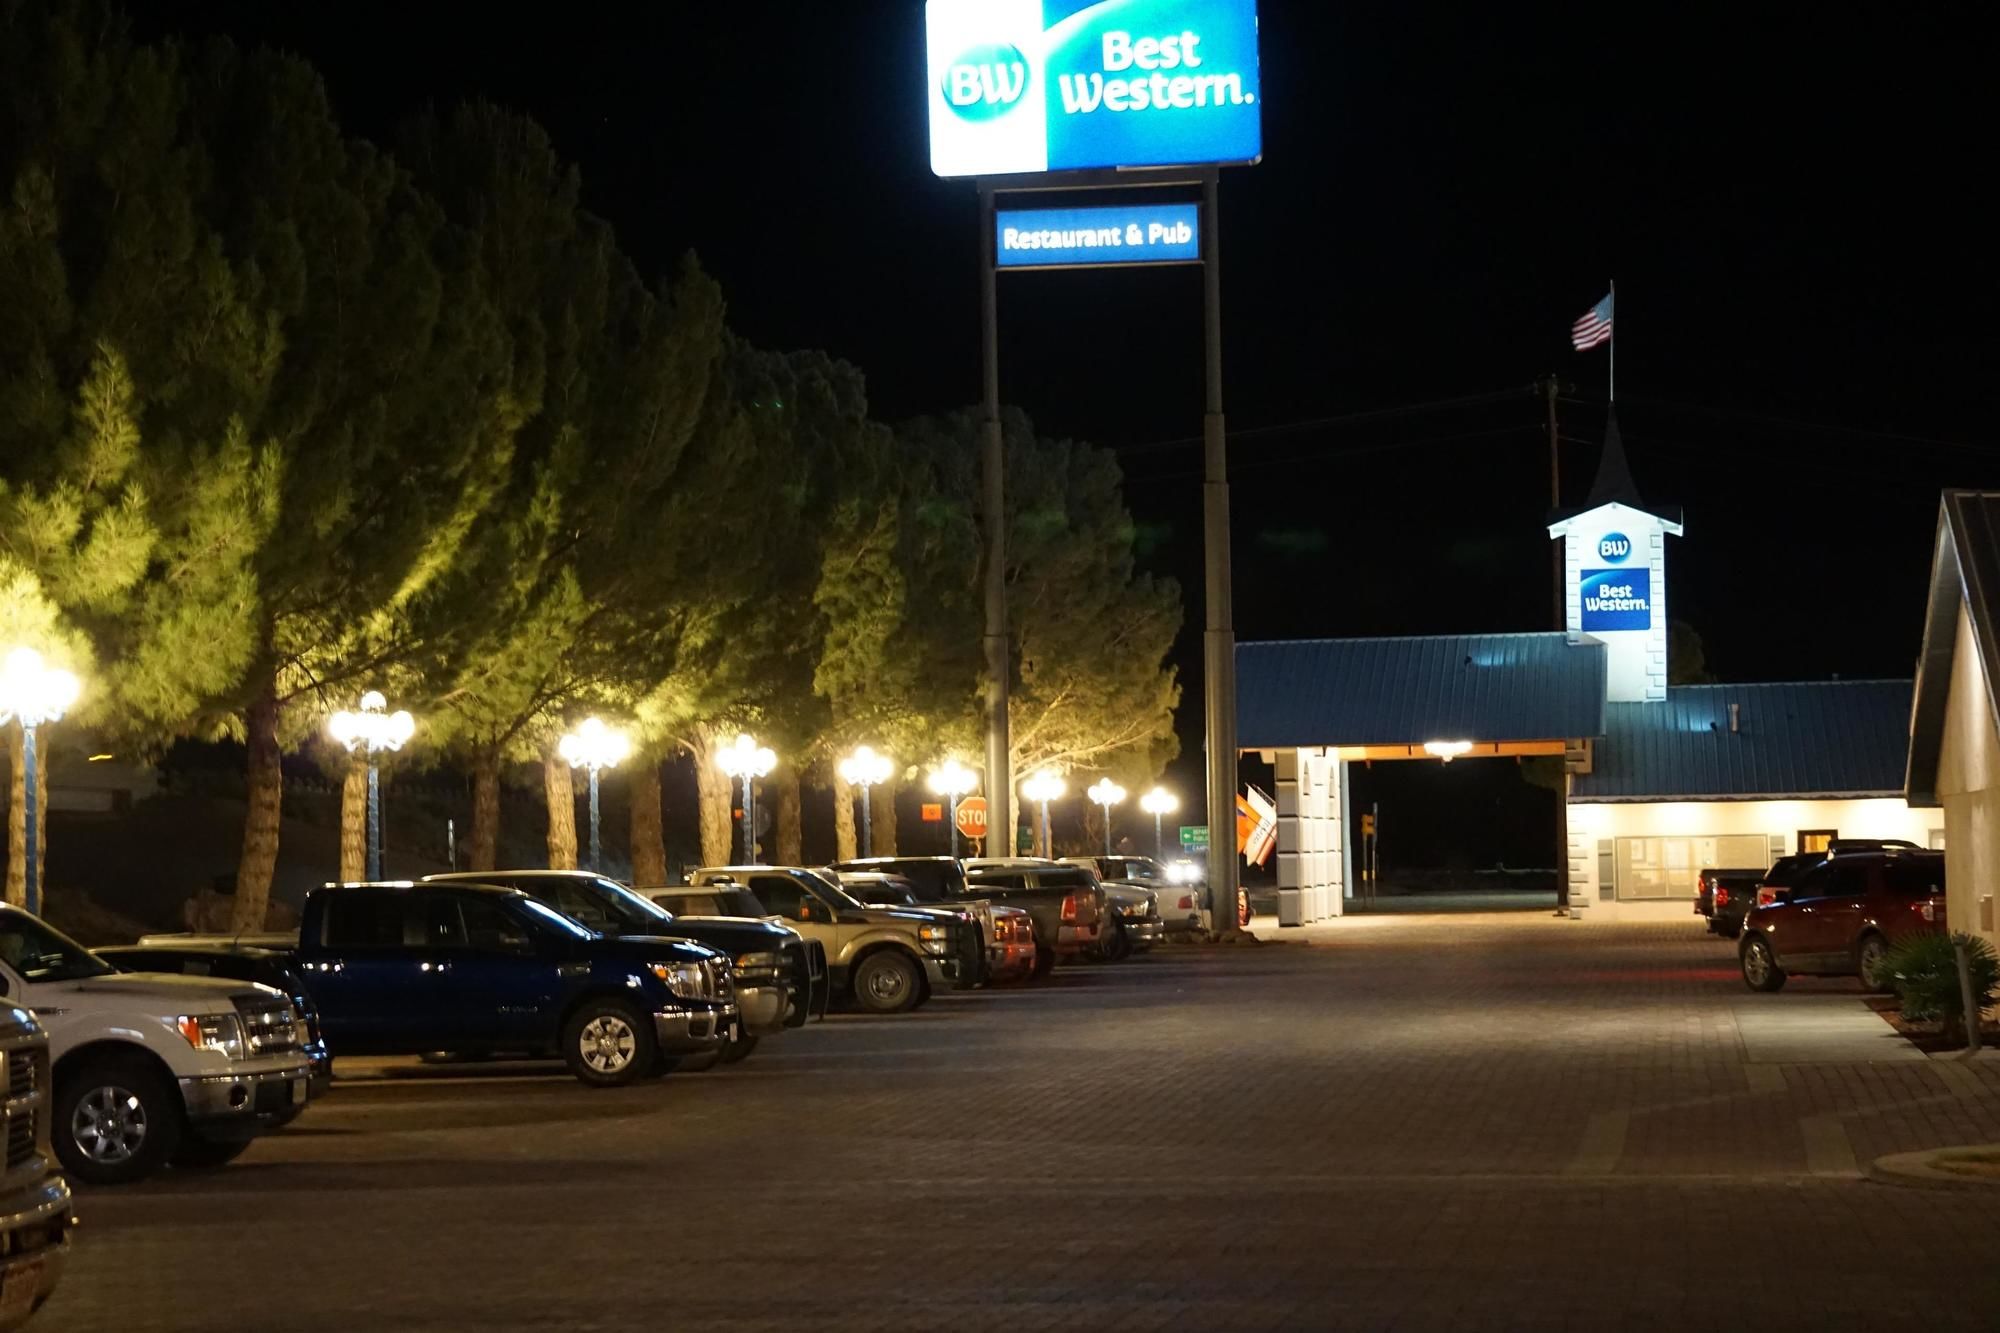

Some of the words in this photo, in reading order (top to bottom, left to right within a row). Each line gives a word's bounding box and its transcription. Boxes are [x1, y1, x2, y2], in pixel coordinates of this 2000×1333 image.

[1102, 31, 1201, 71] Best
[953, 63, 1025, 106] BW
[1004, 228, 1122, 249] Restaurant
[1125, 223, 1143, 246] &
[1148, 221, 1192, 245] Pub
[1601, 540, 1628, 556] BW
[1600, 584, 1632, 598] Best
